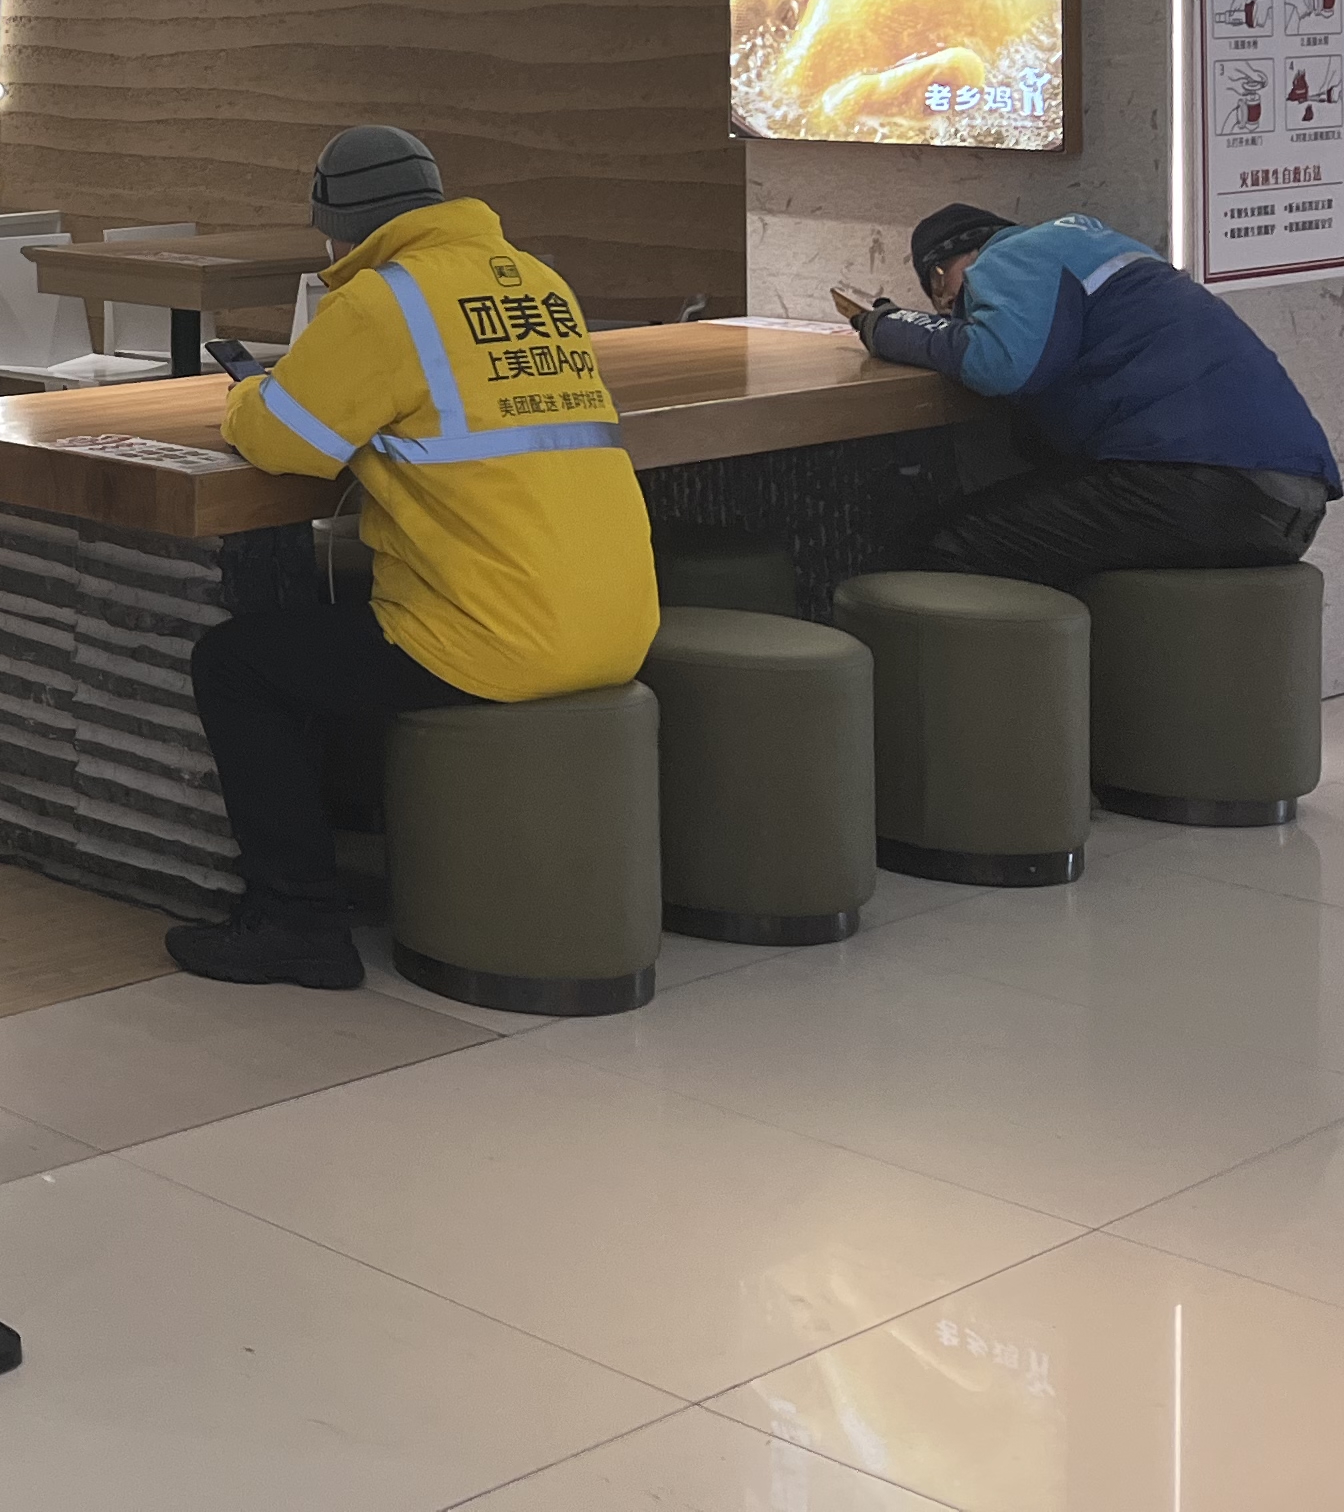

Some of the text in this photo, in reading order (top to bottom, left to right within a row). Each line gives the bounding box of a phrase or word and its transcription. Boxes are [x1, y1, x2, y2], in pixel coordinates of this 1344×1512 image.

[1219, 64, 1225, 76] 3
[1288, 59, 1295, 71] 4
[924, 83, 1013, 112] 老乡鸡
[458, 291, 583, 345] 团美食
[487, 345, 594, 382] 上美团App
